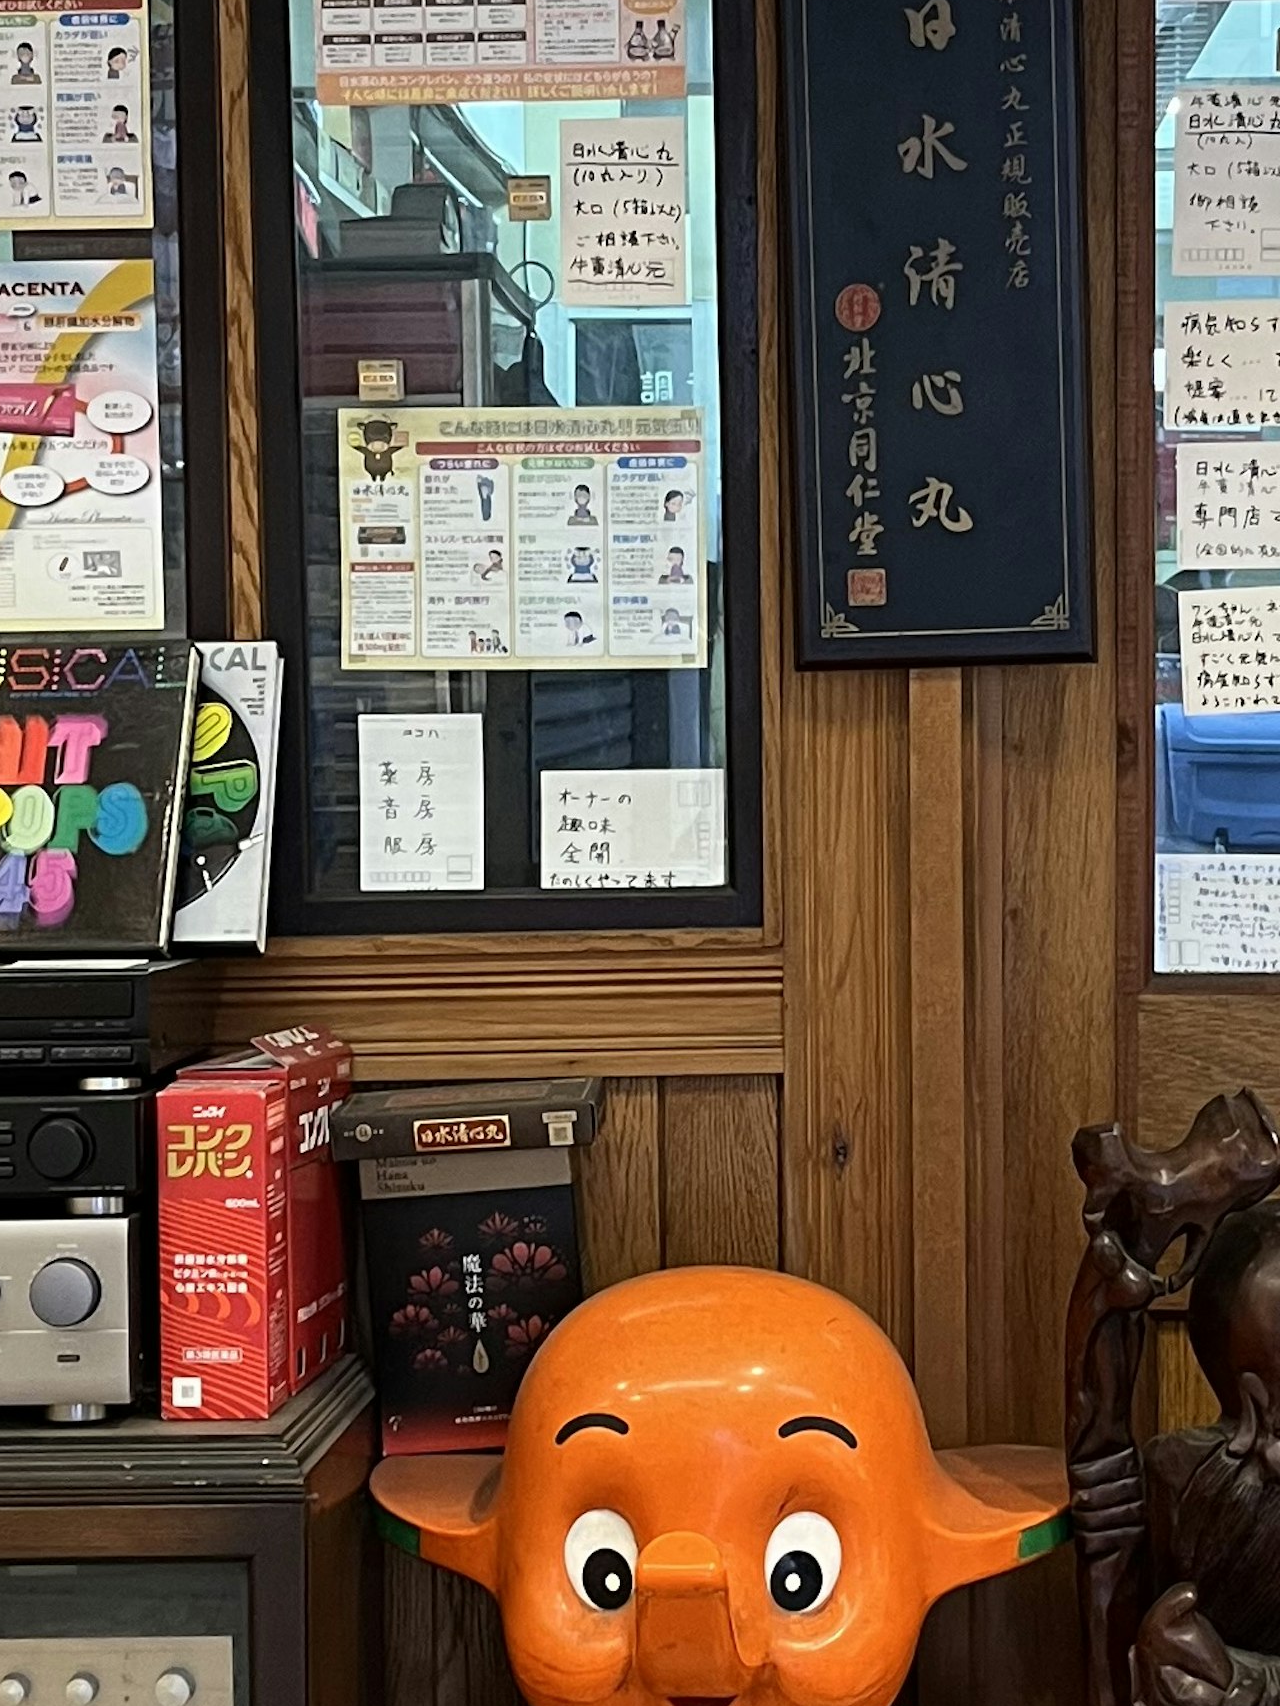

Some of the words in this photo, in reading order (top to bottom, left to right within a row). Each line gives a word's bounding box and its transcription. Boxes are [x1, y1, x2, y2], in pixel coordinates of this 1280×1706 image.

[558, 788, 632, 806] オーナーの
[557, 814, 617, 833] 趣味
[559, 842, 611, 865] 全開
[167, 1124, 253, 1150] コンク
[420, 1124, 504, 1147] 日水清心丸
[167, 1151, 252, 1178] レバン
